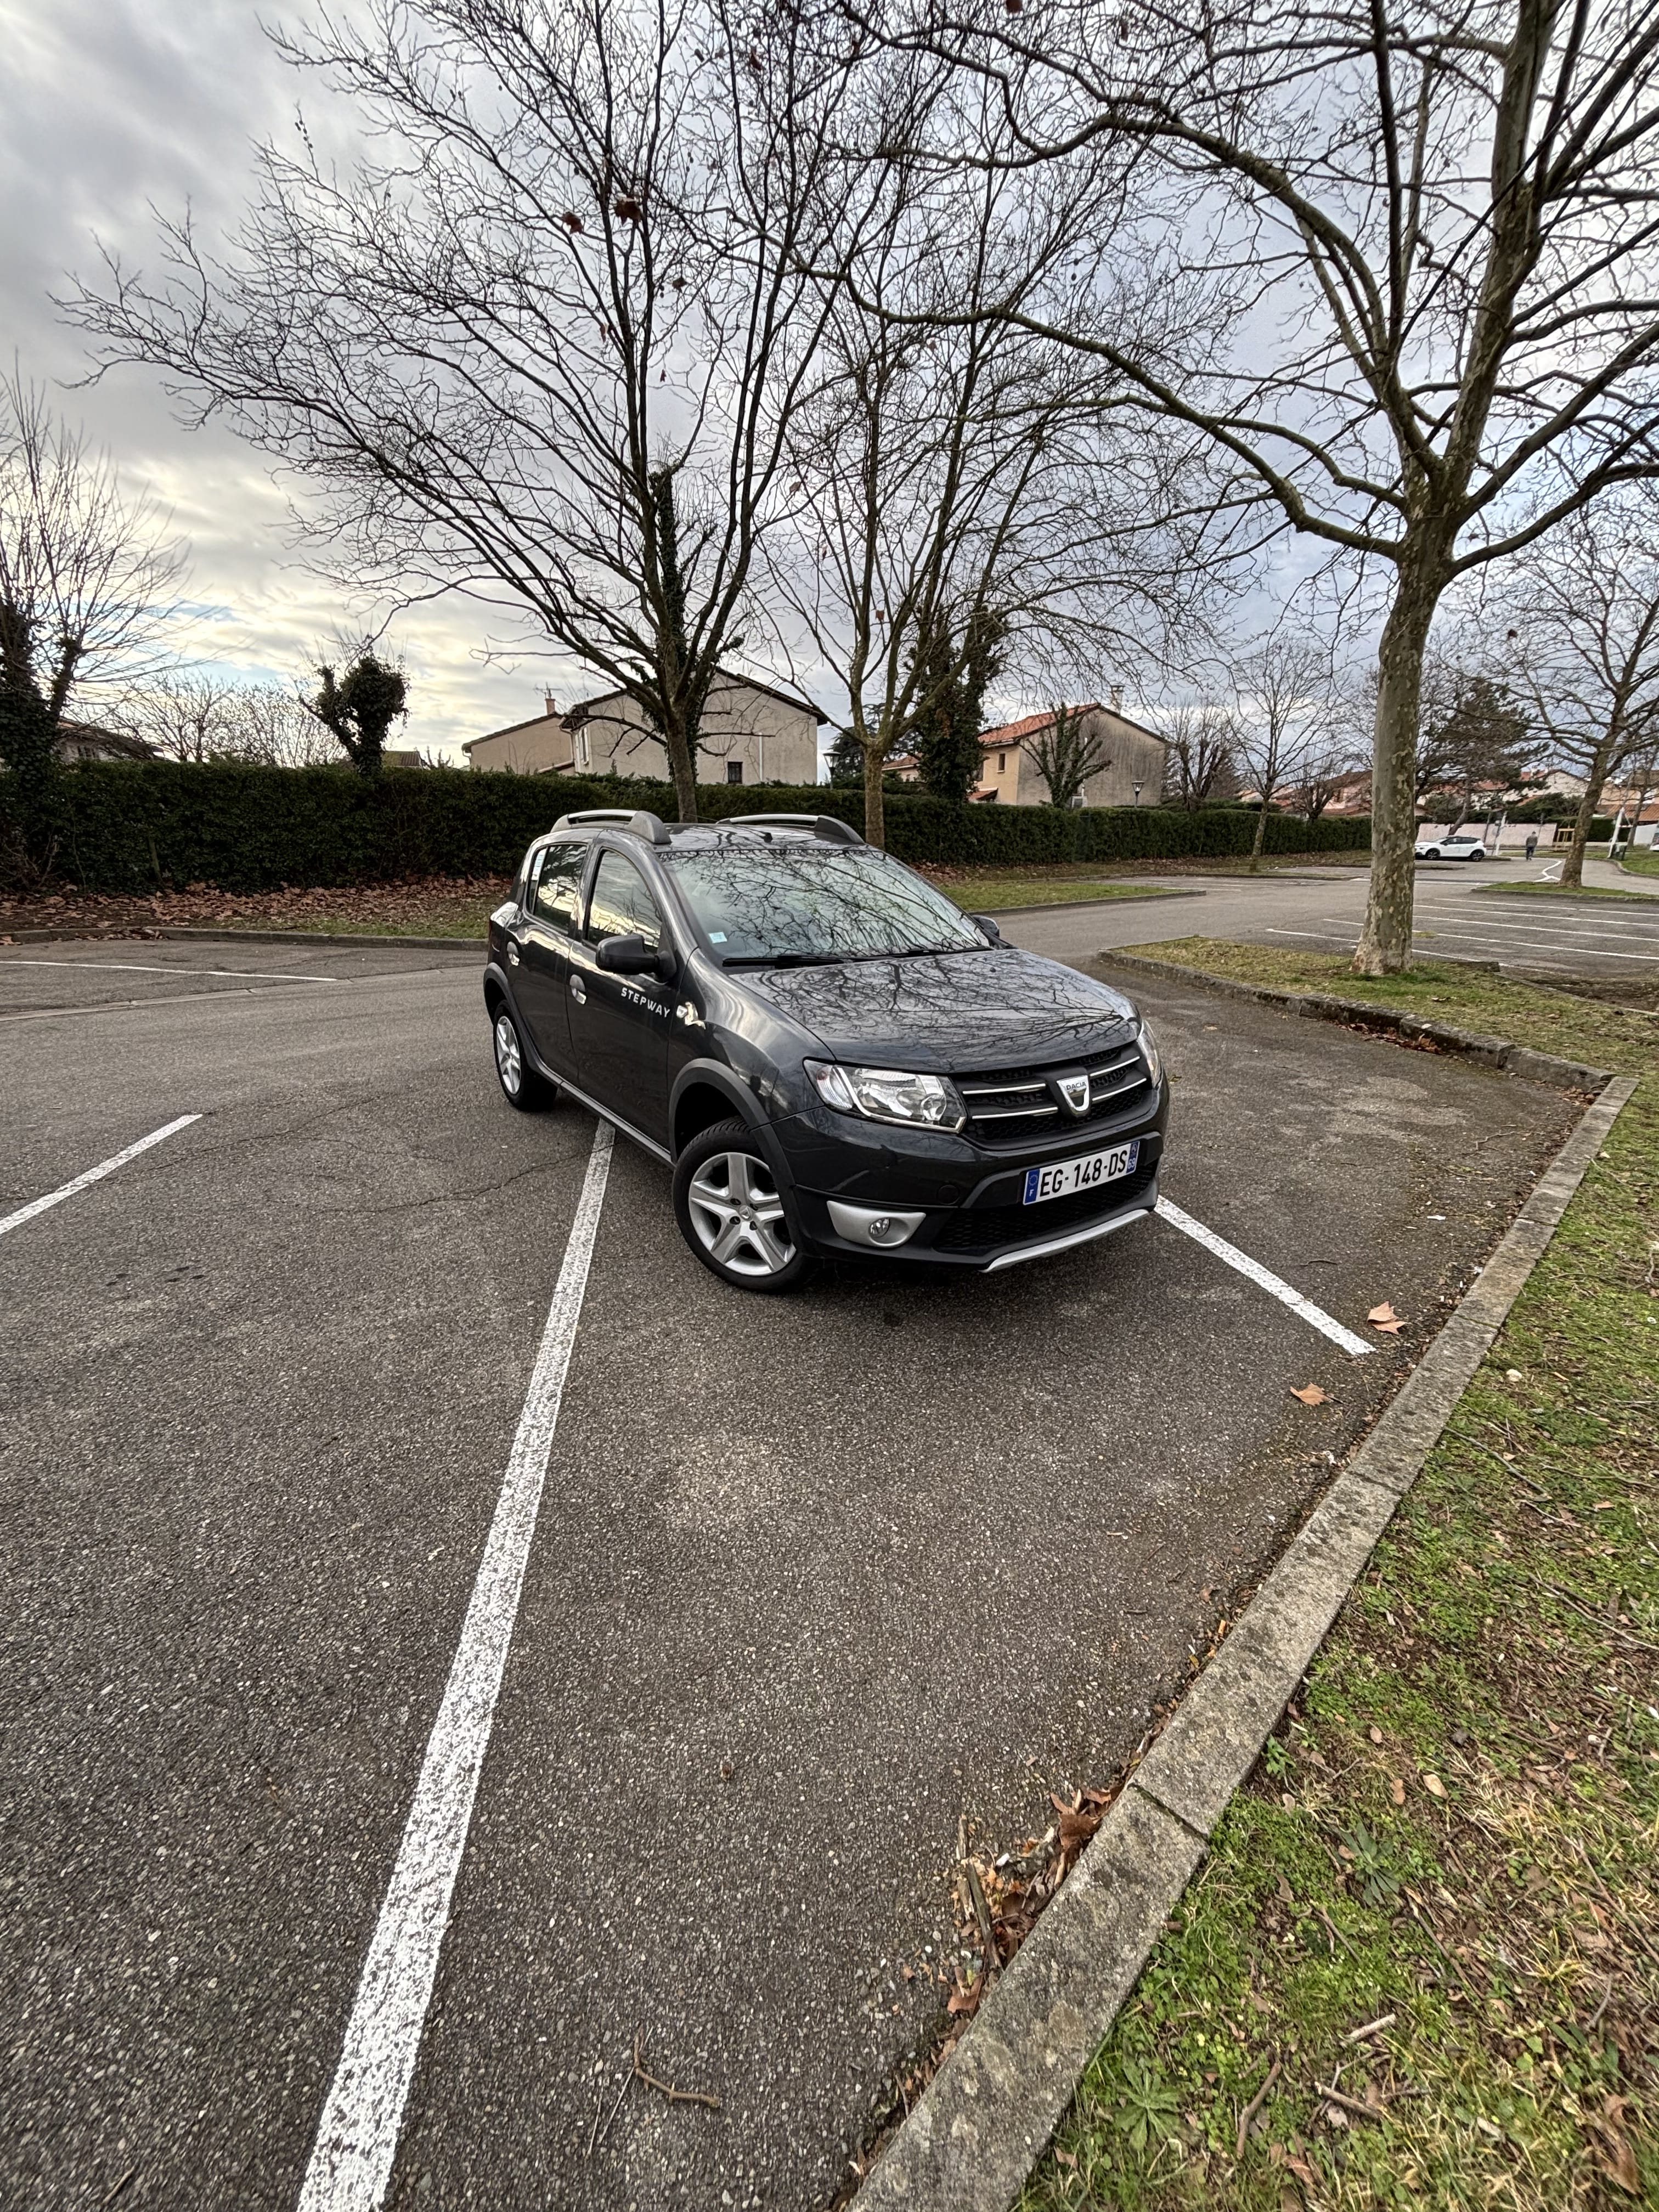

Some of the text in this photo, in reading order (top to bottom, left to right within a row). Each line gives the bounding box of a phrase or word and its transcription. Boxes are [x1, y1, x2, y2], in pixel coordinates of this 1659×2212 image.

[620, 987, 670, 1018] STEPWAY
[1066, 1081, 1087, 1091] DACIA
[1127, 1158, 1136, 1170] 69
[1029, 1189, 1034, 1197] F
